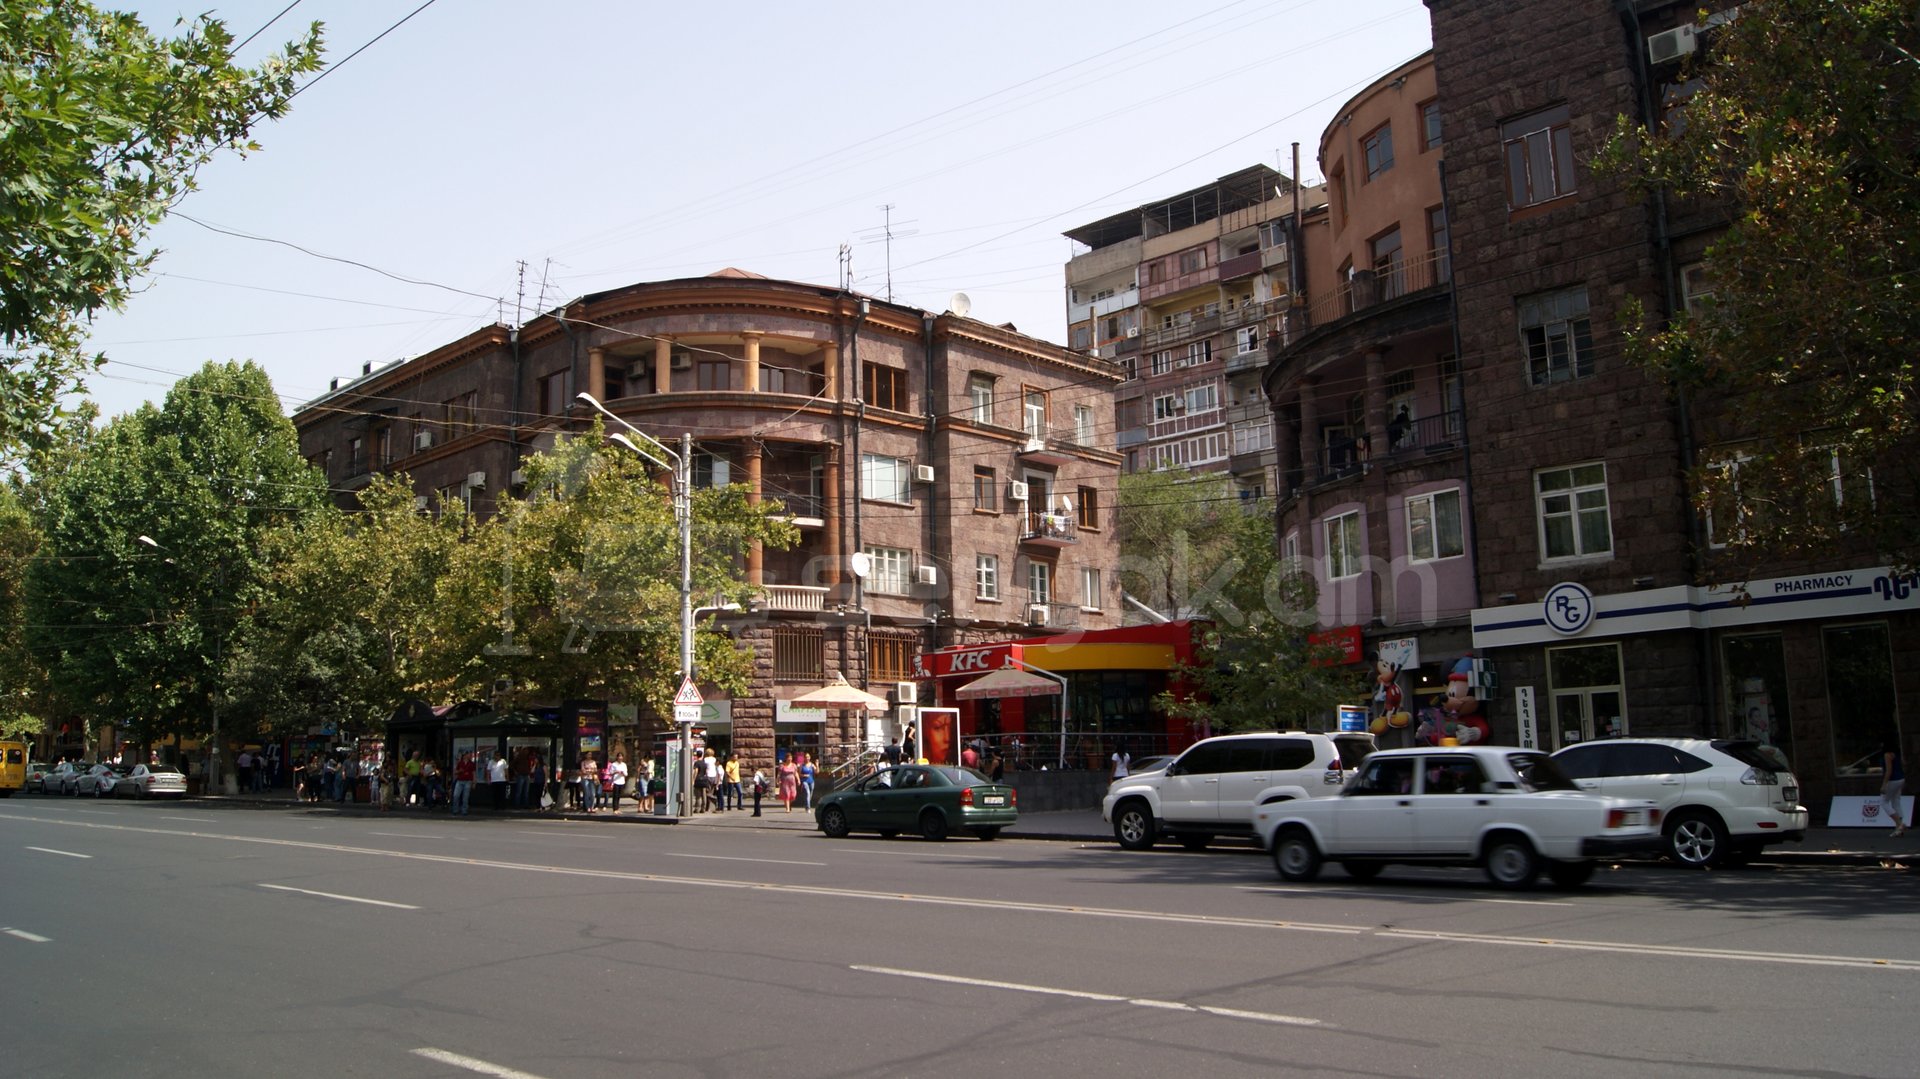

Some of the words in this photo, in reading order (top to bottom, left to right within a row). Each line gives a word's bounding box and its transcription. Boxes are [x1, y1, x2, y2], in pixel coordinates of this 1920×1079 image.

[1774, 575, 1853, 593] PHARMACY
[1380, 641, 1398, 650] Party
[1400, 638, 1414, 648] City
[950, 649, 991, 672] KFC
